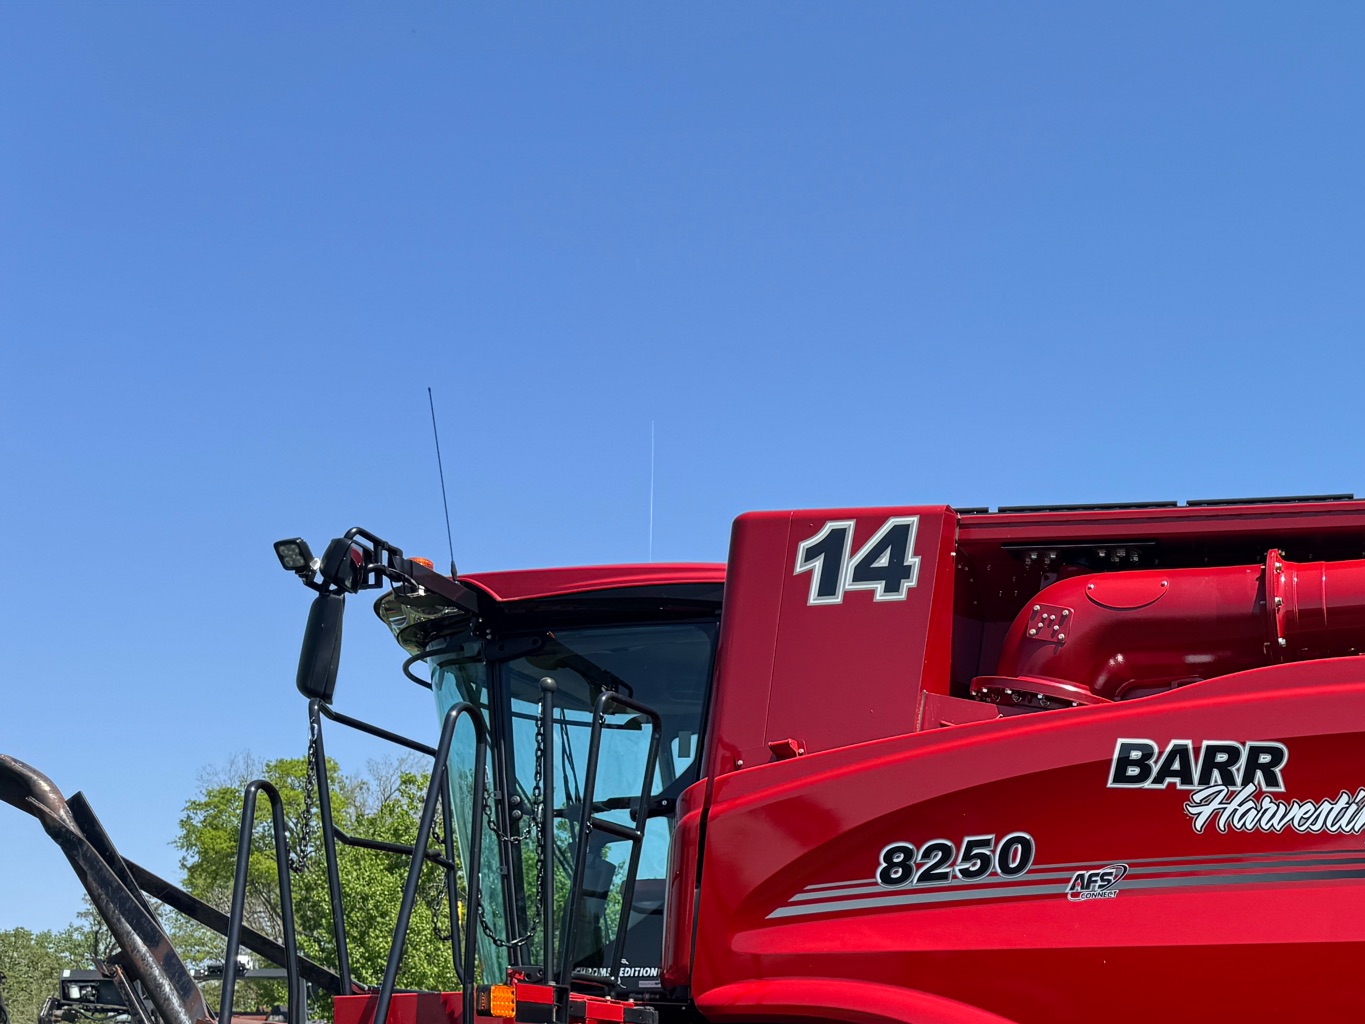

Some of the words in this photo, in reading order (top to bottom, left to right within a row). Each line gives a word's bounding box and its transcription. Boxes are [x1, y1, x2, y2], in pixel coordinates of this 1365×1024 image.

[794, 515, 921, 606] 14
[1106, 737, 1289, 792] BARR
[875, 831, 1036, 888] 8250
[1066, 869, 1116, 892] AFS
[1080, 890, 1119, 899] CONNECT
[619, 967, 659, 977] EDITION
